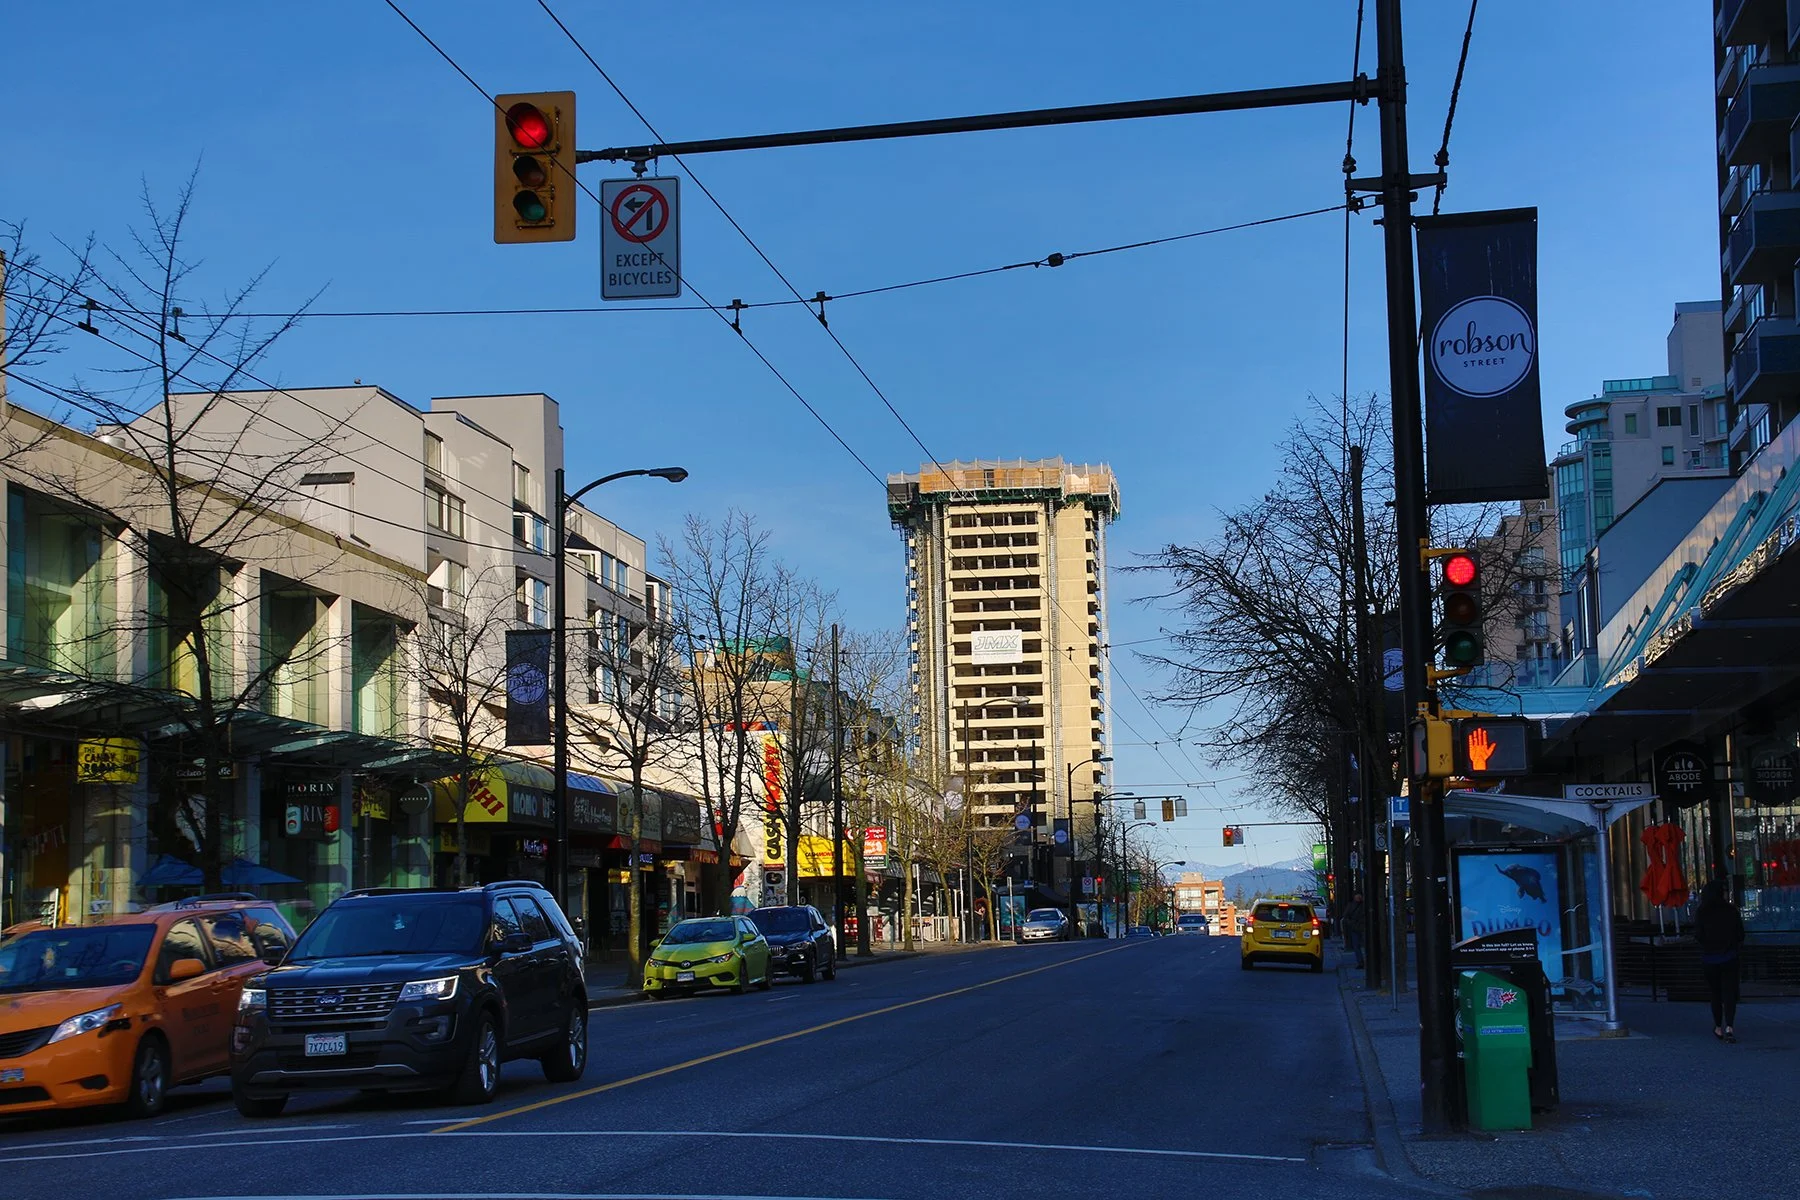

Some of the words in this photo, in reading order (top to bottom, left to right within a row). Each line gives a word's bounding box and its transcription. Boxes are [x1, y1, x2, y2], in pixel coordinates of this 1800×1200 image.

[616, 253, 665, 267] EXCEPT
[609, 271, 672, 286] BICYCLES
[1440, 320, 1533, 357] robson
[1463, 357, 1506, 368] STREET
[974, 635, 1019, 650] JMX
[1668, 773, 1702, 781] ABODE
[287, 783, 334, 793] HORIN
[1574, 786, 1643, 797] COCKTAILS
